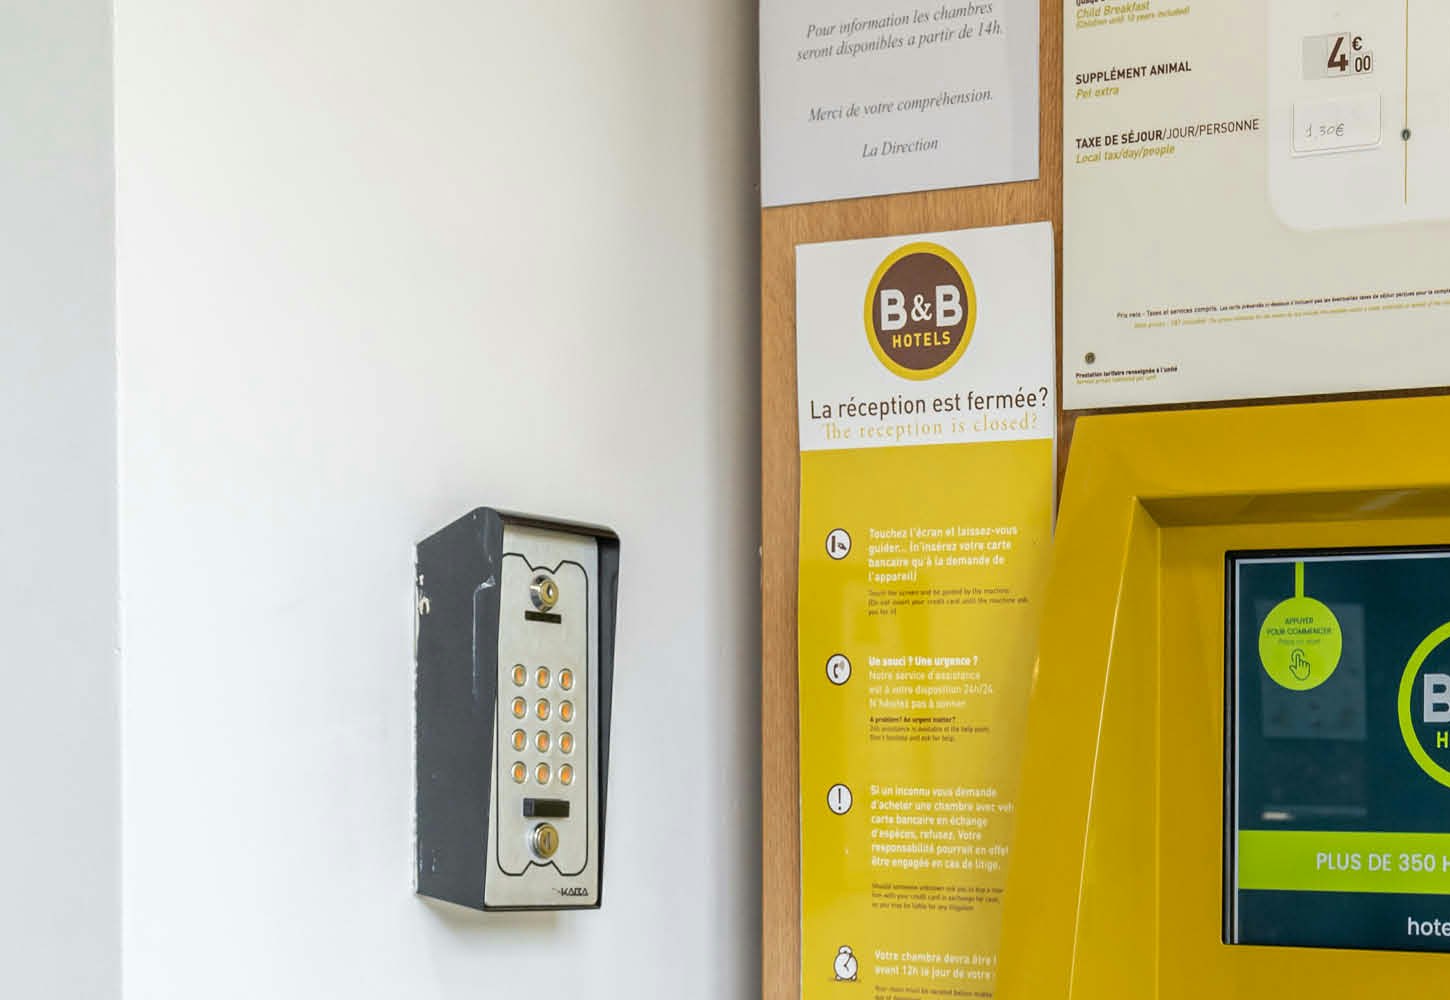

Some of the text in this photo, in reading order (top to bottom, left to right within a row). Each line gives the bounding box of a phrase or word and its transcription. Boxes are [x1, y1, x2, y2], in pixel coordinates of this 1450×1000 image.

[806, 2, 992, 38] Pour information les chambres
[797, 45, 833, 60] seront
[835, 34, 903, 56] disponibles
[907, 35, 915, 46] a
[917, 28, 954, 48] partir
[957, 24, 973, 39] de
[1327, 36, 1349, 72] 4
[1075, 61, 1191, 84] SUPPLÉMENT ANIMAL
[1354, 55, 1372, 73] 00
[808, 89, 992, 120] Merci de votre compréhension.
[862, 138, 938, 158] La Direction
[1075, 136, 1101, 148] TAXE
[1104, 134, 1118, 146] DE
[880, 284, 964, 331] B&B
[892, 331, 951, 349] HOTELS
[811, 387, 1048, 419] La réception est fermée?
[823, 412, 1040, 441] The reception is closed?
[1316, 852, 1361, 870] PLUS
[1368, 853, 1391, 871] DE
[1399, 853, 1436, 871] 350
